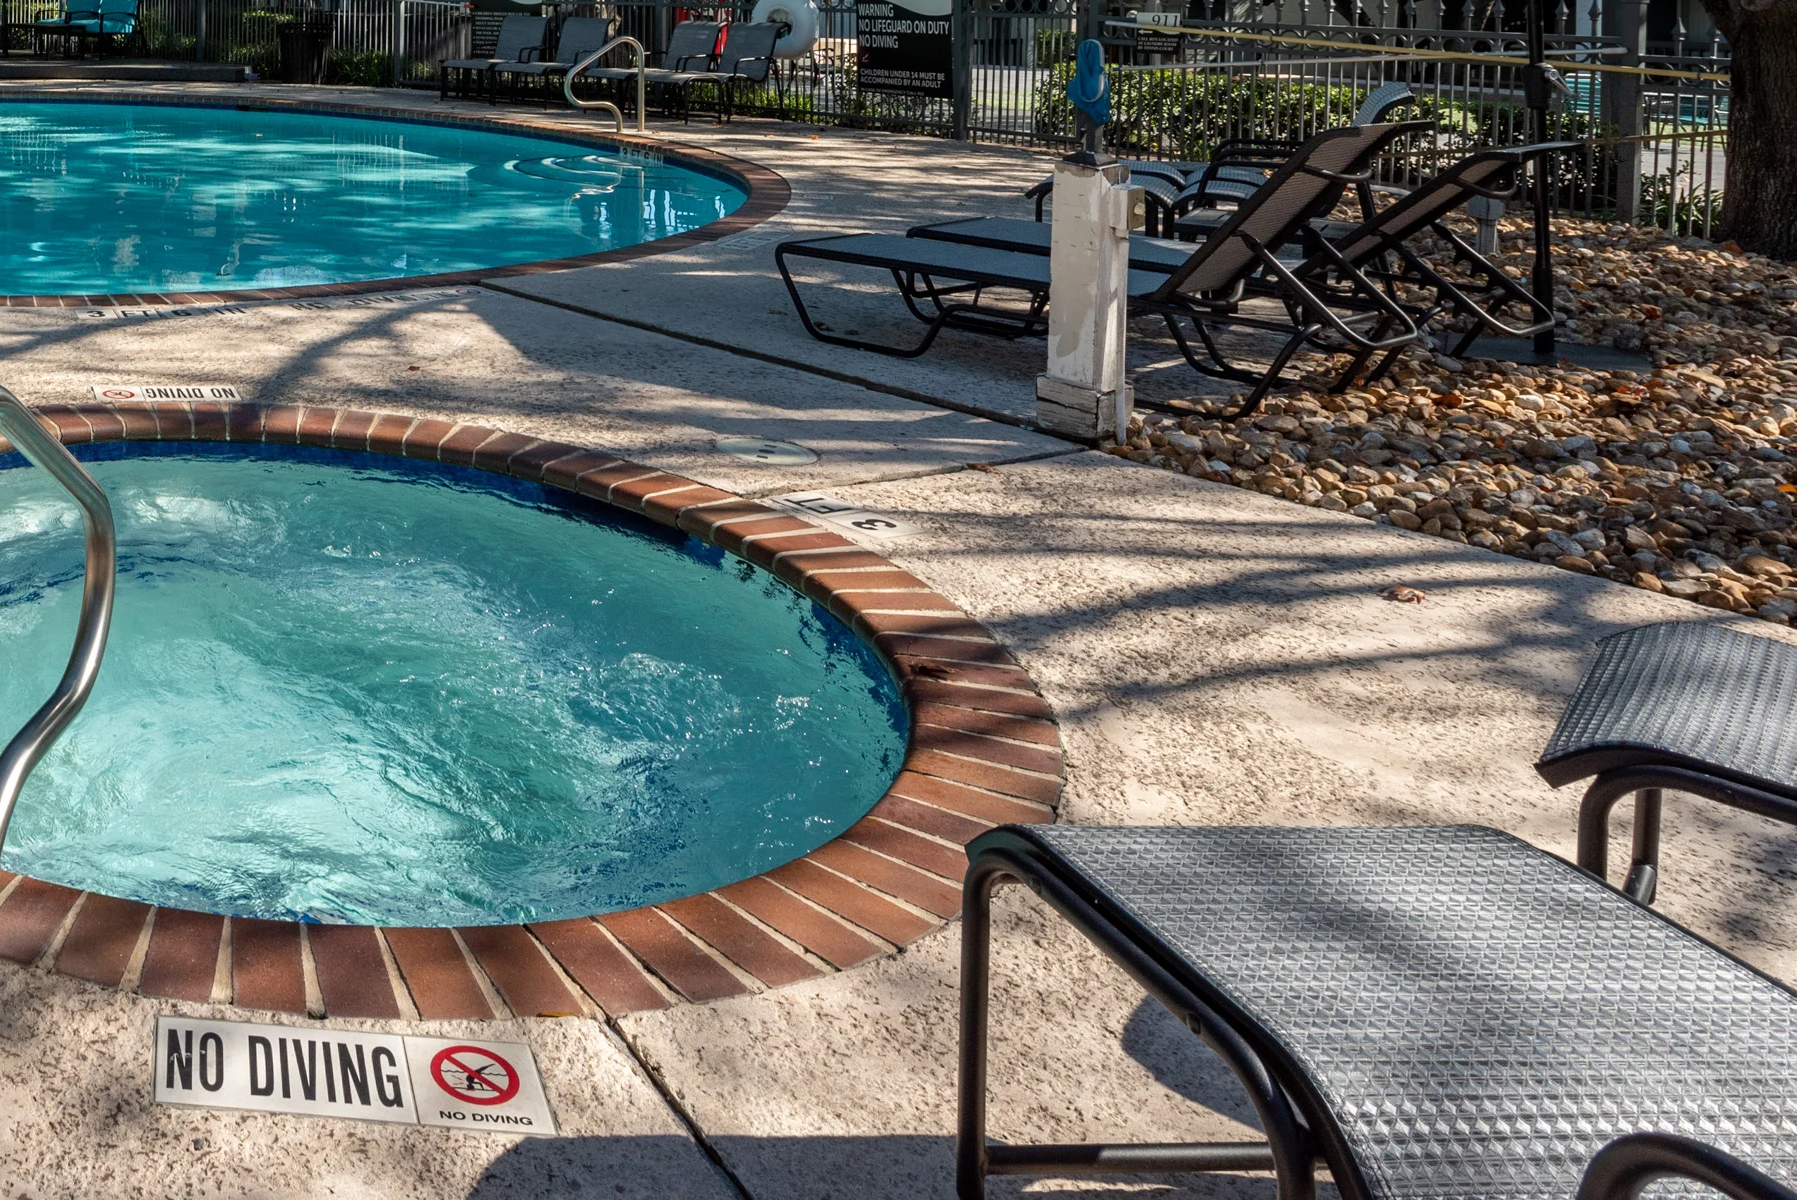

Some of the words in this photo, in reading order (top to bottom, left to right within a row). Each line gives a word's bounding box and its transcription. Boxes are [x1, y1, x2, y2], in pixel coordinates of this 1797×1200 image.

[858, 3, 894, 17] WARNING
[859, 19, 871, 32] NO
[872, 19, 913, 33] LIFEGUARD
[914, 20, 926, 34] ON
[928, 21, 950, 35] DUTY
[1152, 14, 1178, 27] 911
[859, 34, 871, 48] NO
[872, 35, 899, 48] DIVING
[860, 68, 889, 76] CHILDREN
[890, 70, 910, 78] UNDER
[911, 71, 919, 79] 14
[919, 72, 936, 80] MUST
[937, 73, 945, 81] BE
[860, 76, 902, 86] ACCOMPANIED
[921, 80, 941, 89] ADULT
[86, 310, 106, 318] 3
[121, 310, 152, 318] FT
[171, 309, 192, 317] 6
[212, 307, 247, 315] IN
[145, 387, 205, 399] DIVING
[210, 387, 236, 399] NO
[784, 498, 853, 514] FT
[851, 518, 897, 531] 3
[165, 1028, 225, 1092] NO
[248, 1034, 404, 1109] DIVING
[438, 1109, 467, 1122] NO
[470, 1112, 533, 1127] DIVING
